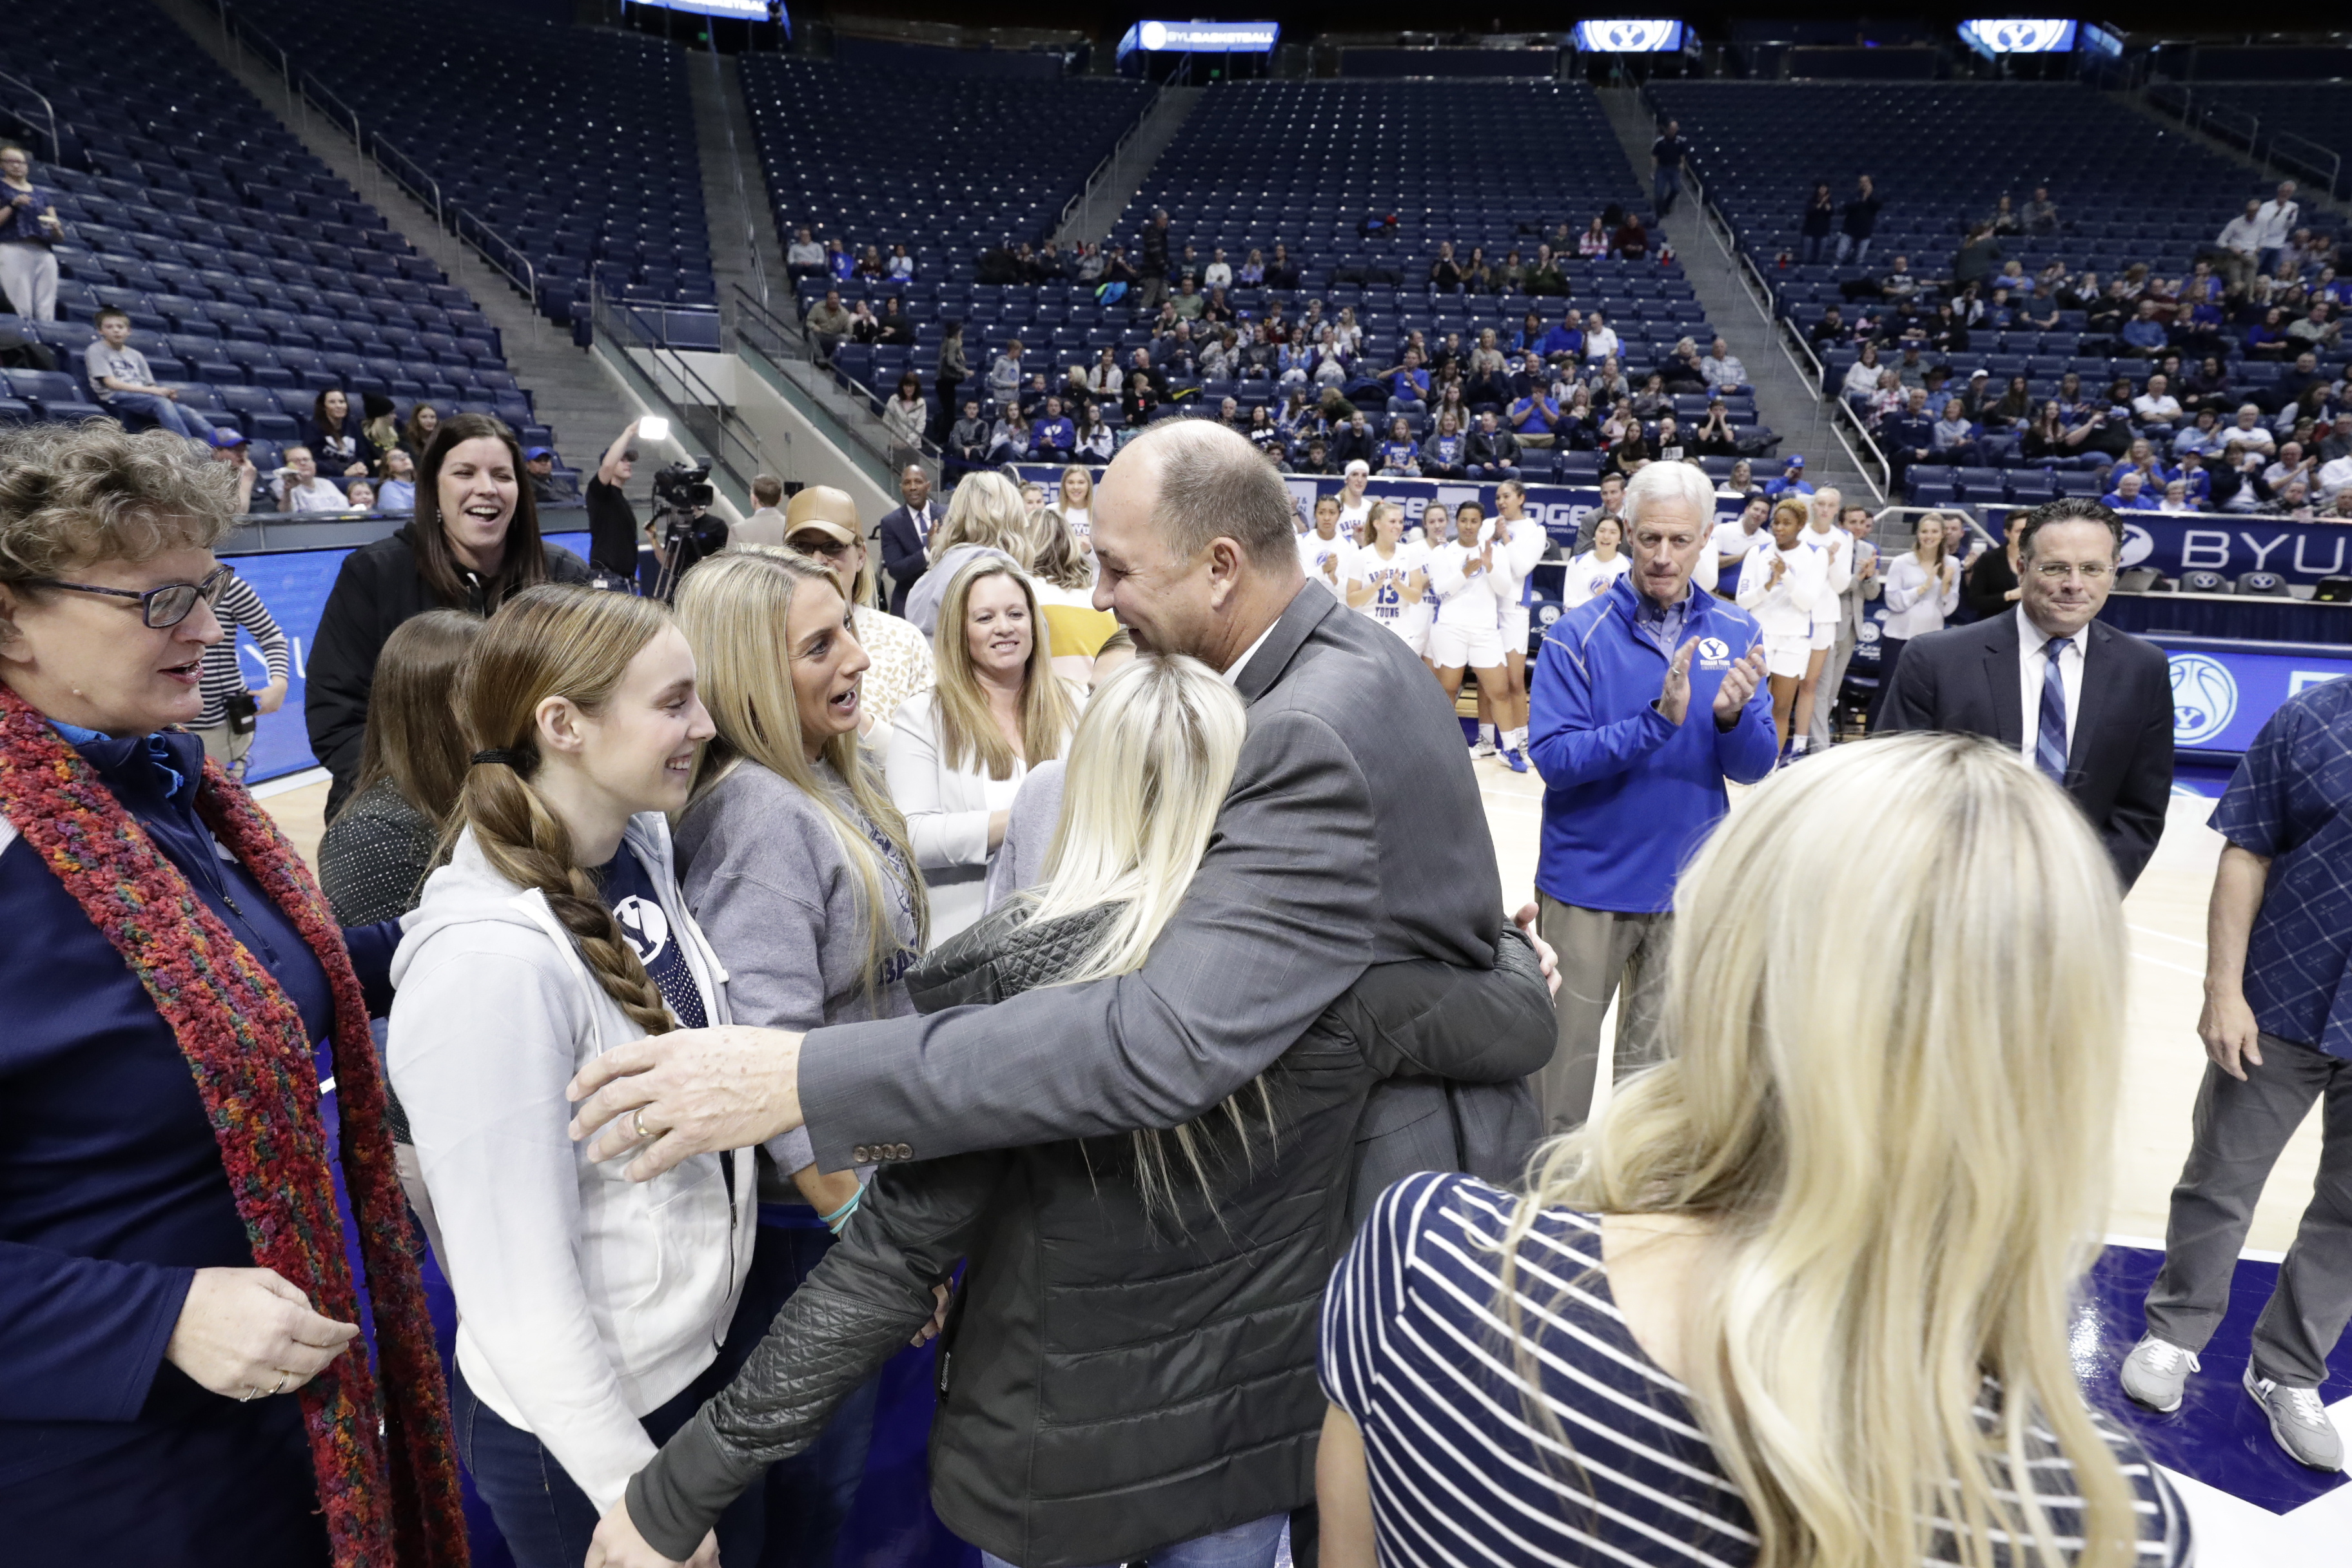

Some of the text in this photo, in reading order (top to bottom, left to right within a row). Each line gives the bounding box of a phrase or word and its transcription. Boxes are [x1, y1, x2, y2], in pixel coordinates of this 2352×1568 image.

[2181, 529, 2346, 574] BYU
[1378, 583, 1399, 604] 13
[1375, 607, 1400, 618] YOUNG
[1703, 640, 1723, 658] Y
